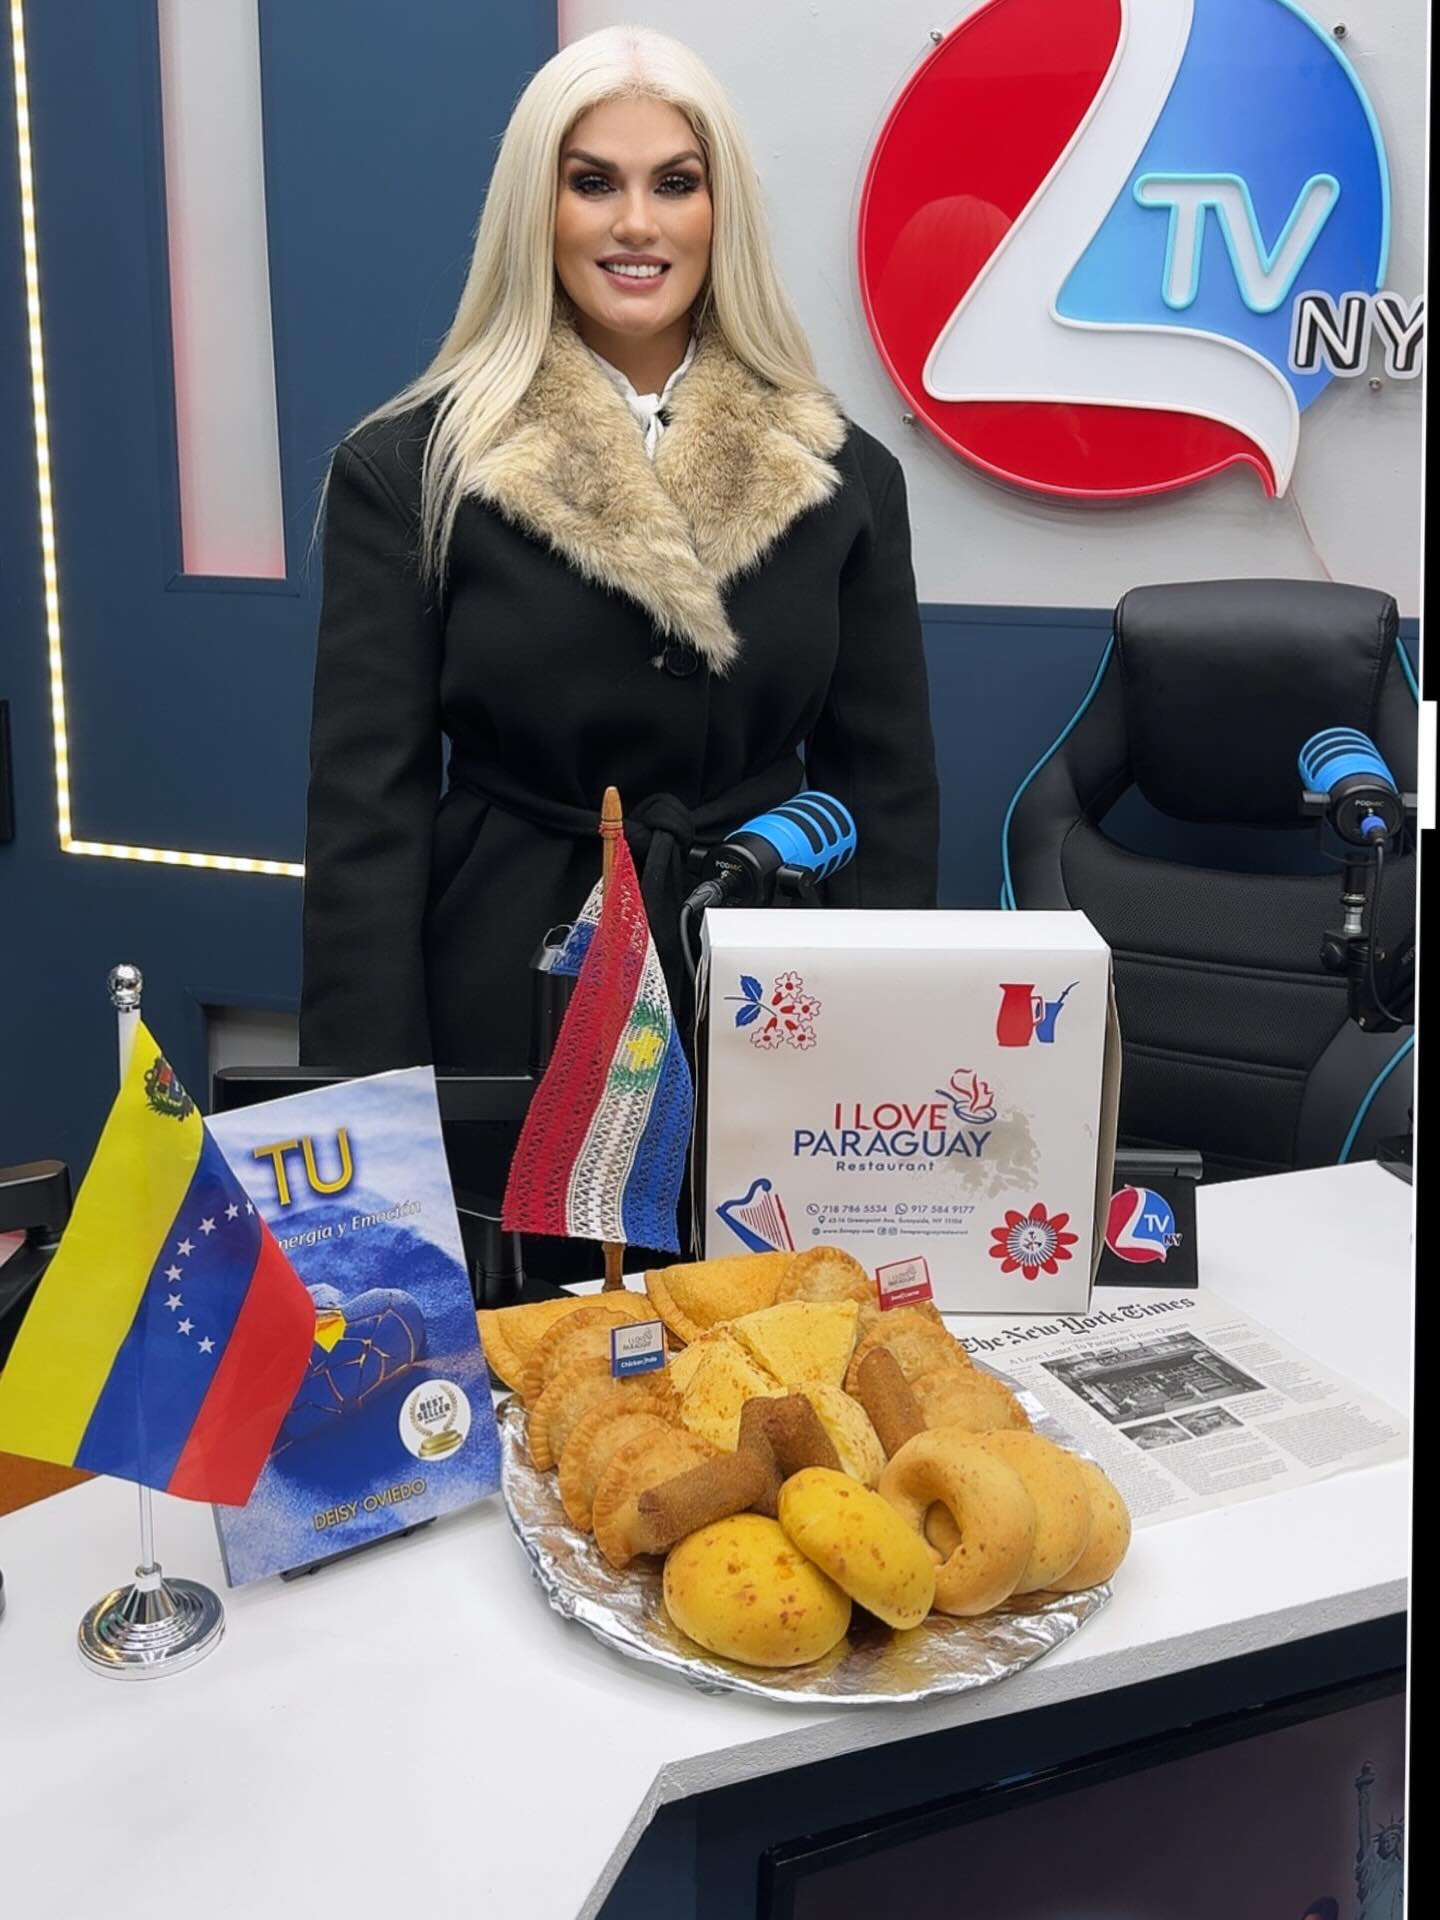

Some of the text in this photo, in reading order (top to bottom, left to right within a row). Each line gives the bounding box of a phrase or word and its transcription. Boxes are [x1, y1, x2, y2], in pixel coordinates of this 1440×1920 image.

[1133, 173, 1341, 313] TV
[1291, 292, 1423, 377] NY
[834, 1103, 948, 1131] I LOVE
[793, 1130, 992, 1158] PARAGUAY
[253, 1127, 354, 1206] TU
[836, 1160, 935, 1172] Restaurant
[336, 1222, 347, 1238] y
[351, 1200, 422, 1232] Emoción
[822, 1205, 839, 1214] 718
[842, 1205, 861, 1214] 786
[911, 1205, 928, 1214] 917
[952, 1205, 975, 1214] 9177
[1143, 1213, 1171, 1233] TV
[957, 1336, 1003, 1353] The
[1001, 1325, 1058, 1345] New
[1056, 1310, 1120, 1336] York
[1117, 1297, 1197, 1320] Times
[416, 1402, 451, 1421] SELLER
[419, 1396, 444, 1412] BEST
[313, 1478, 427, 1531] DEISY OVIEDO
